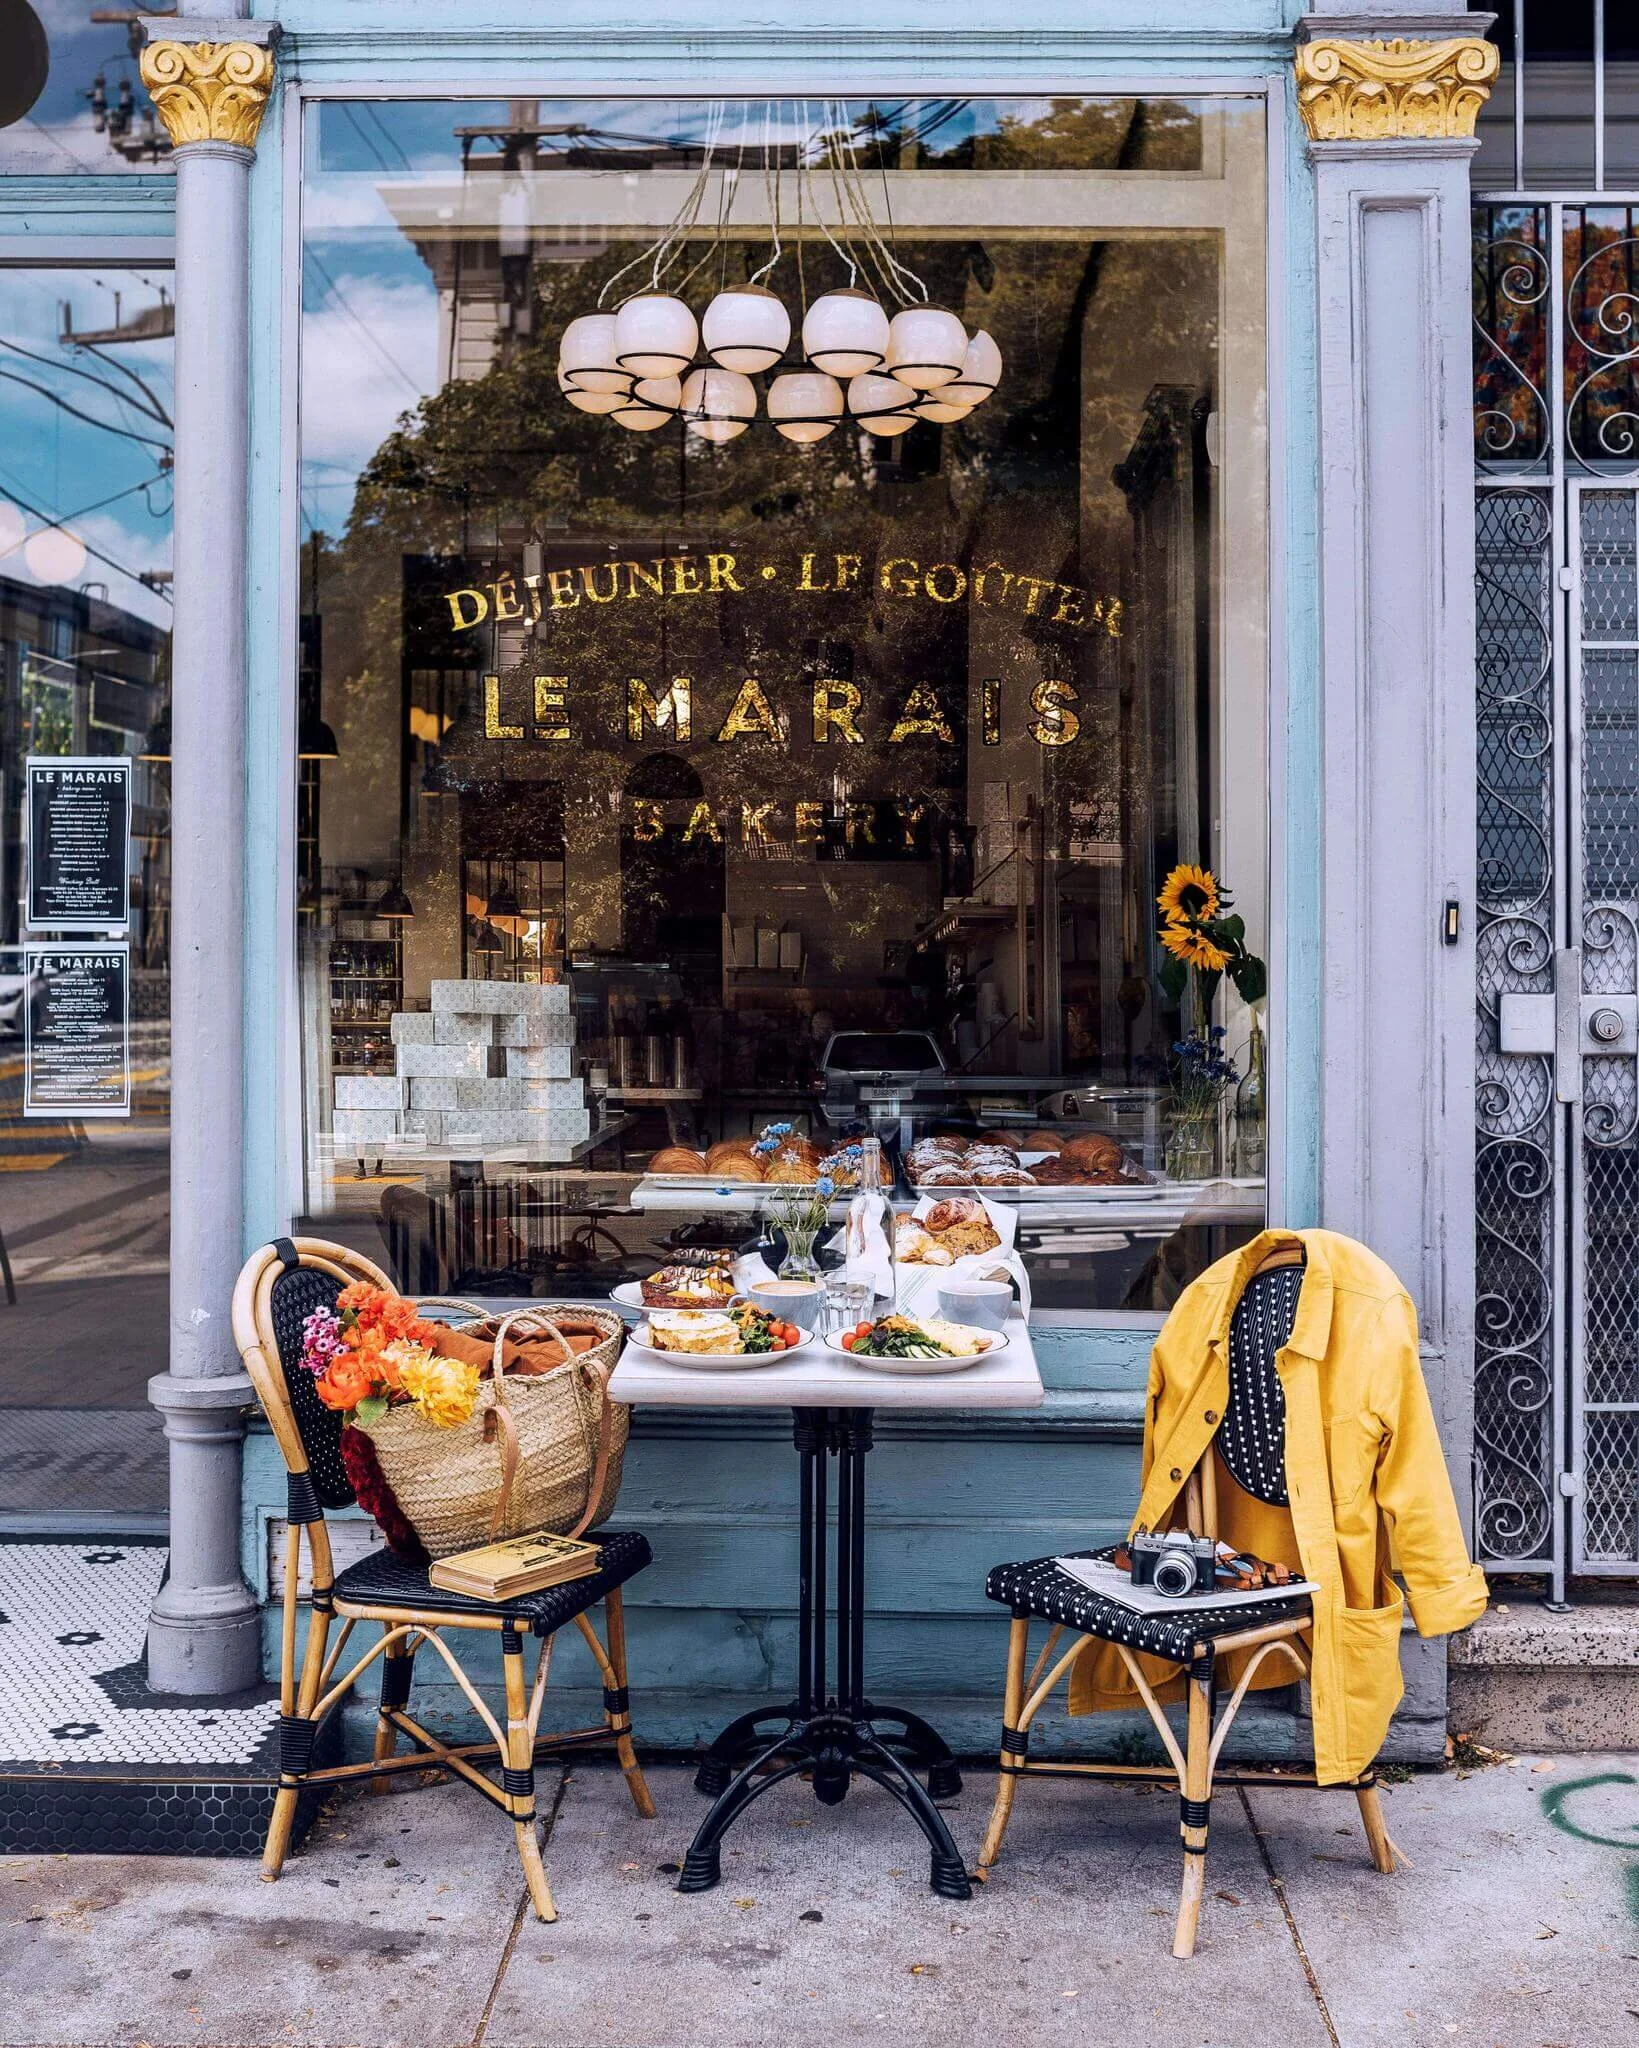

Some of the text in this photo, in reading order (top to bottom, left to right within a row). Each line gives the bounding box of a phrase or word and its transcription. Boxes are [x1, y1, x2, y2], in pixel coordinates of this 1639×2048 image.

[444, 553, 746, 632] DÉJEUNER
[482, 675, 1082, 746] LE MARAIS
[36, 772, 122, 783] LE MARAIS
[34, 957, 120, 969] LE MARAIS
